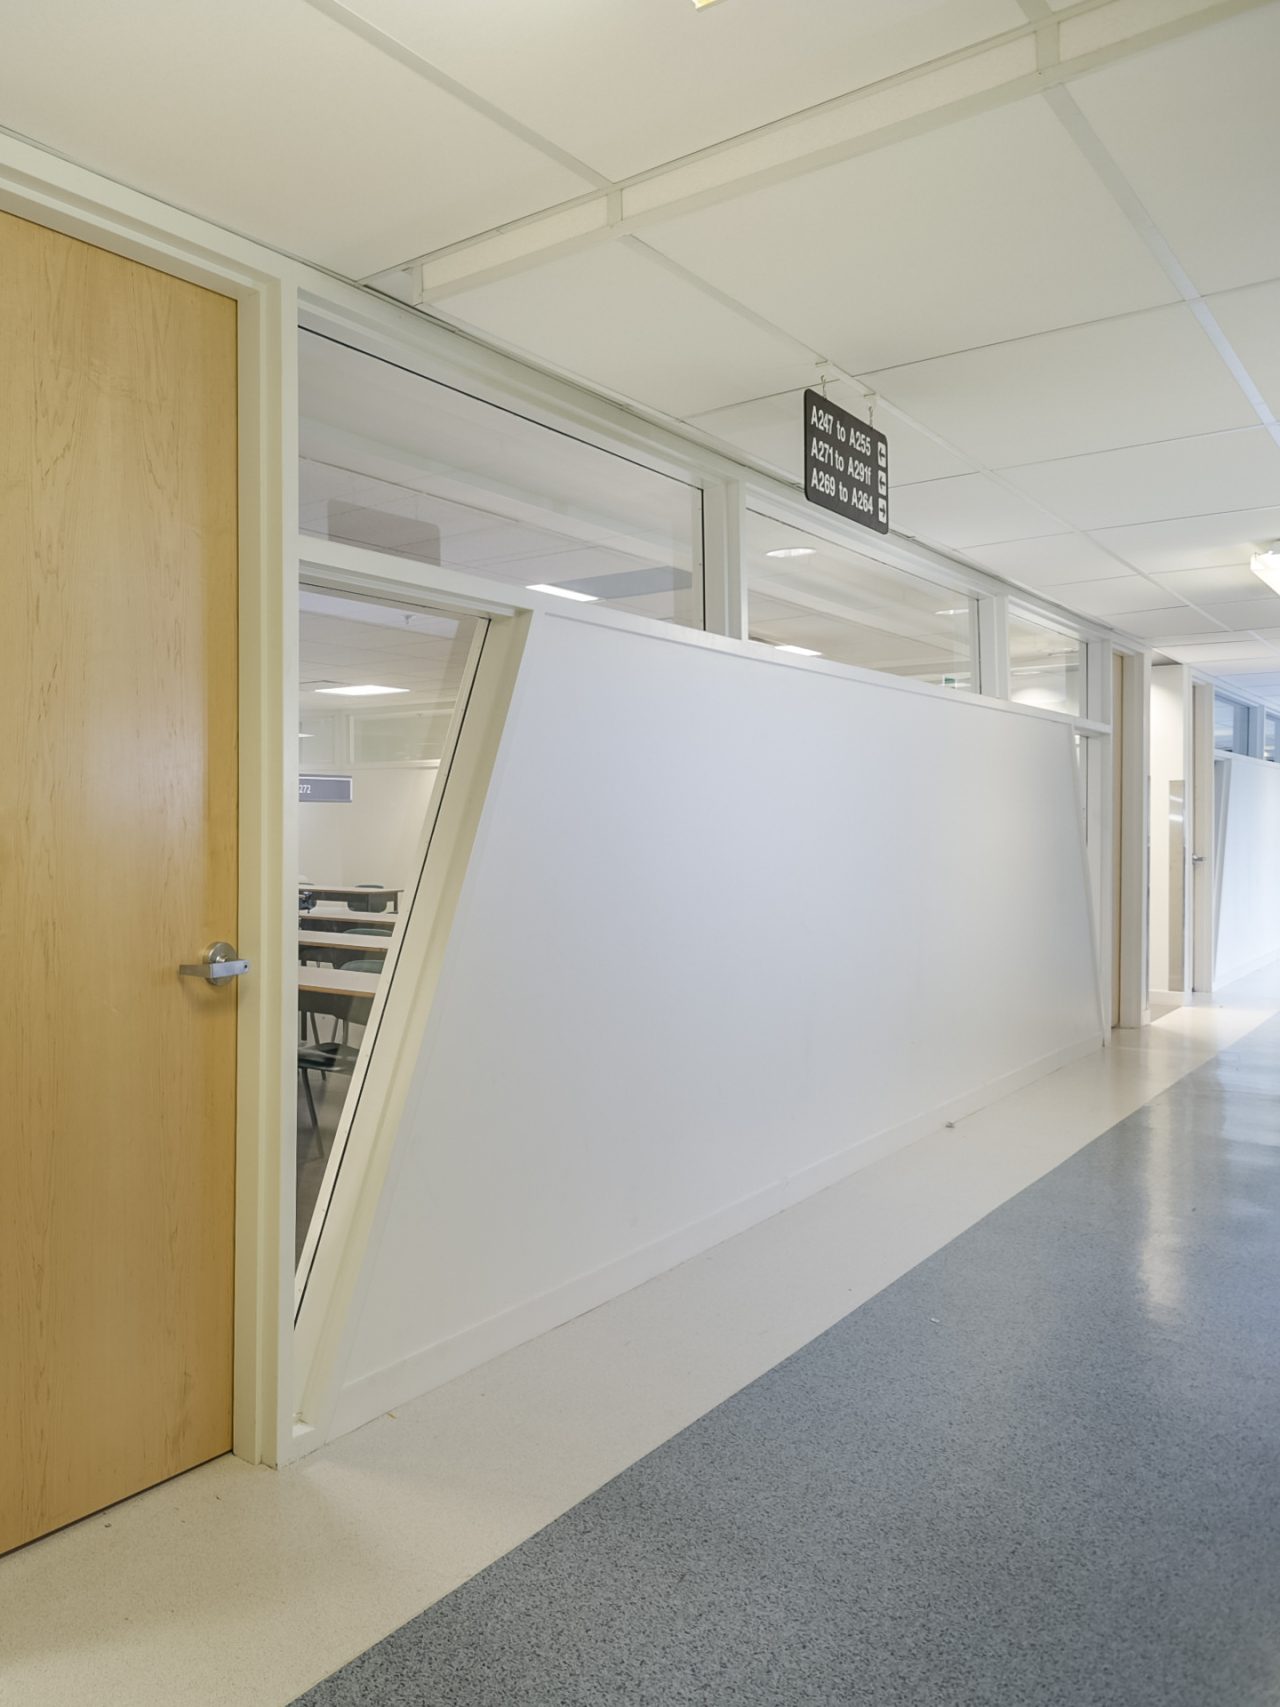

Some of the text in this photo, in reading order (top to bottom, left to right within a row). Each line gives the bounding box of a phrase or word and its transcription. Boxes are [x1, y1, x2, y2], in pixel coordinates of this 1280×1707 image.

[811, 405, 871, 456] A247 to A255
[811, 437, 834, 466] A271
[835, 450, 844, 472] to
[811, 468, 873, 515] A269 to A264
